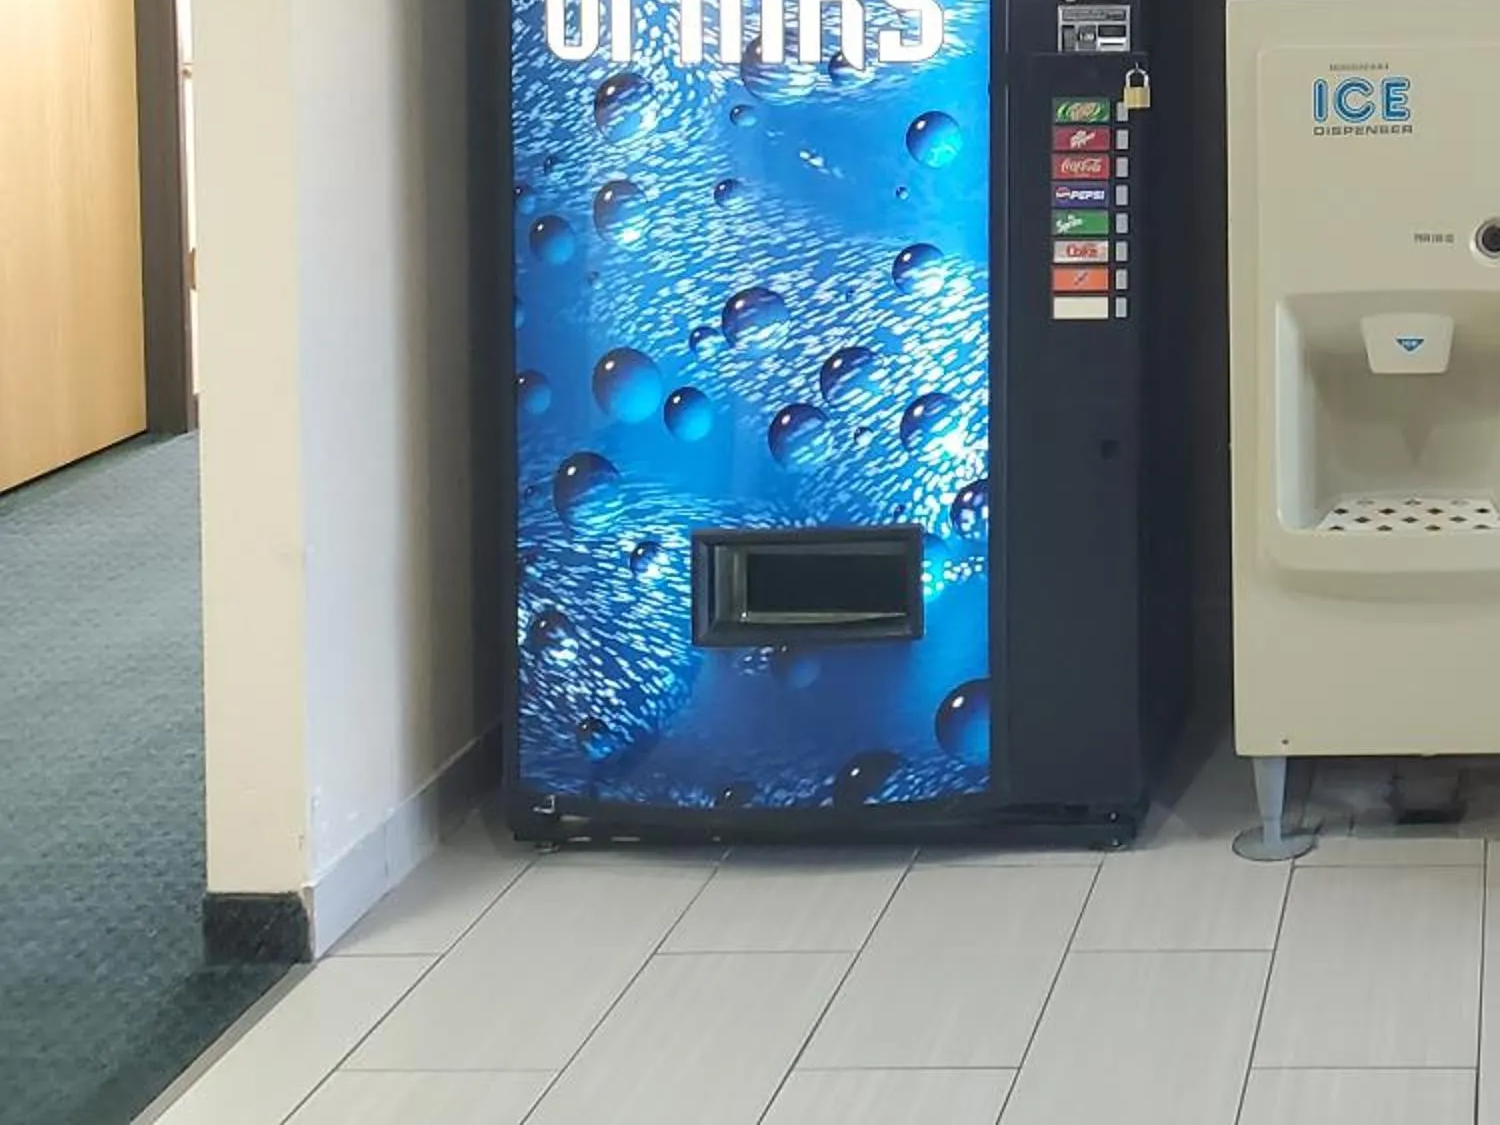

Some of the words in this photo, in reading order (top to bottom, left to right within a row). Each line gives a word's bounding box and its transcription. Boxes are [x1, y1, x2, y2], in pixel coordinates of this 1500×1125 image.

[1313, 76, 1411, 123] ICE
[1313, 124, 1413, 136] DISPENSER
[1070, 190, 1105, 200] PEPSI
